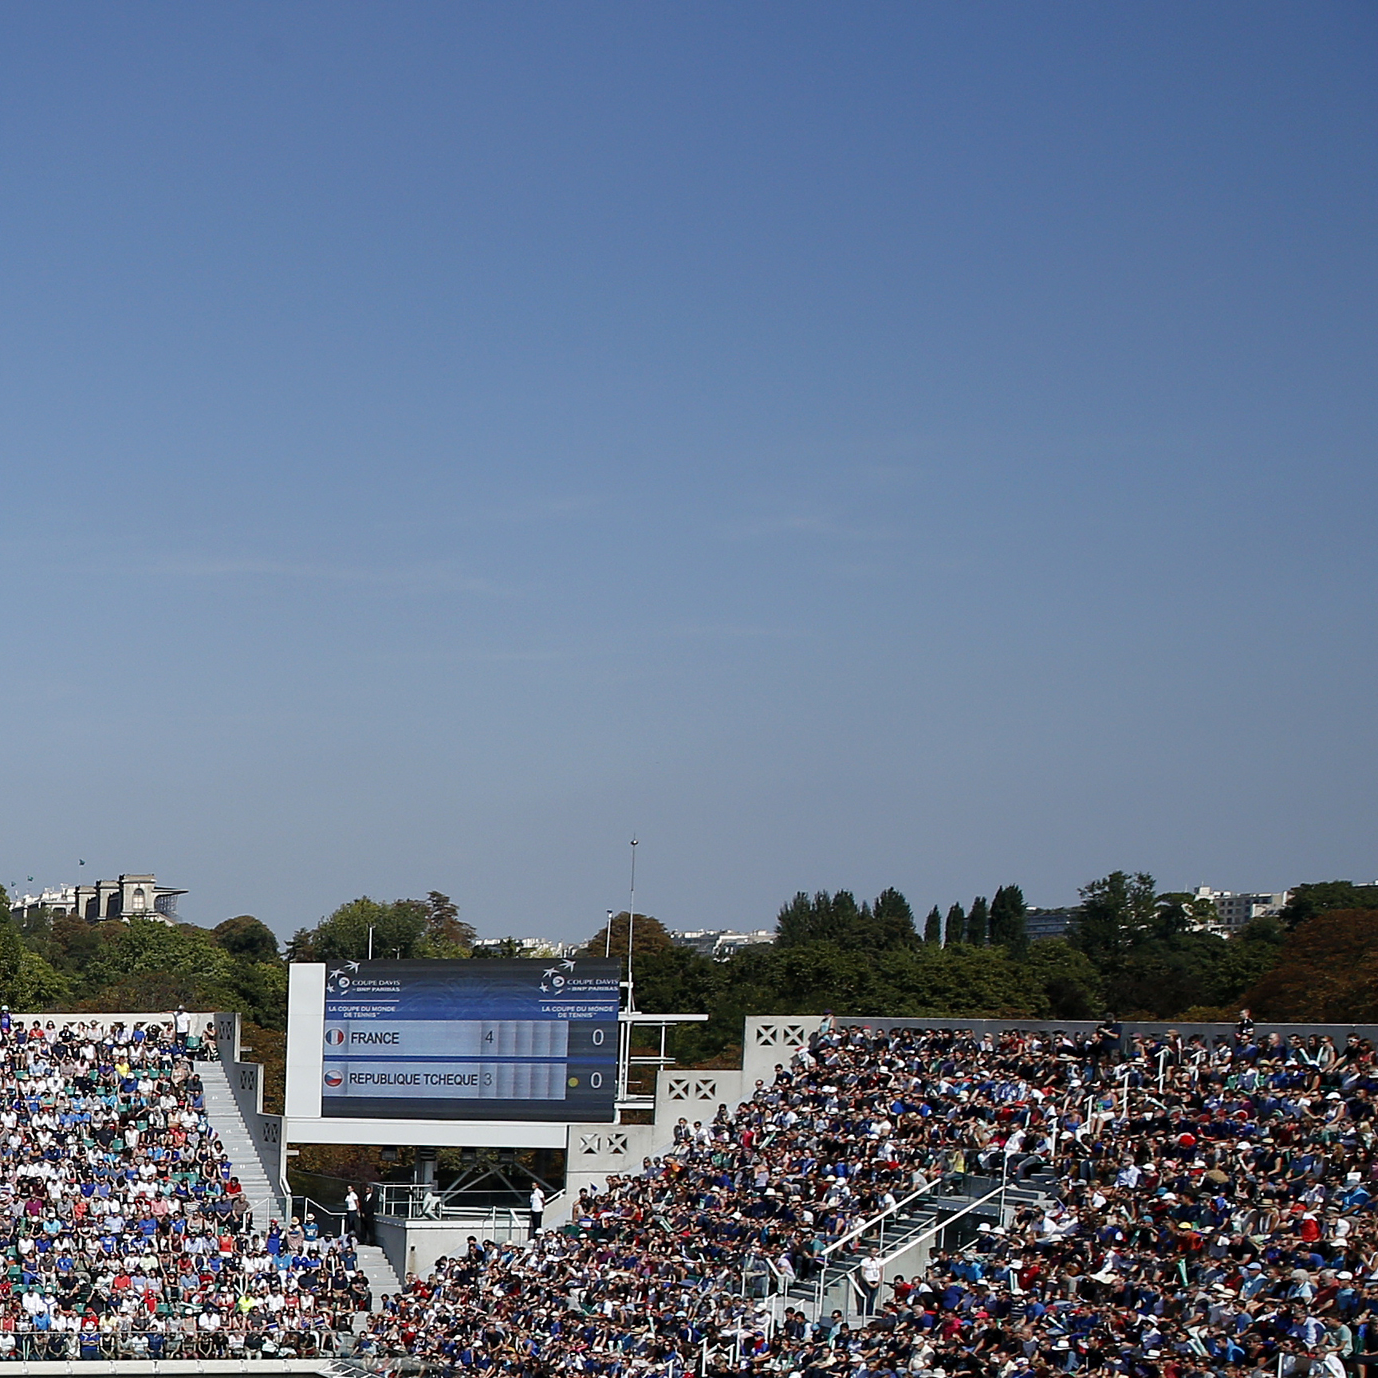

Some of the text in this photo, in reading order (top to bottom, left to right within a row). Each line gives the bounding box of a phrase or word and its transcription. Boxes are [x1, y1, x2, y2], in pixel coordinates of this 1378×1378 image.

[351, 1029, 604, 1046] FRANCE 4 0
[349, 1072, 603, 1089] REPUBLIQUE TCHEQUE 3 0
